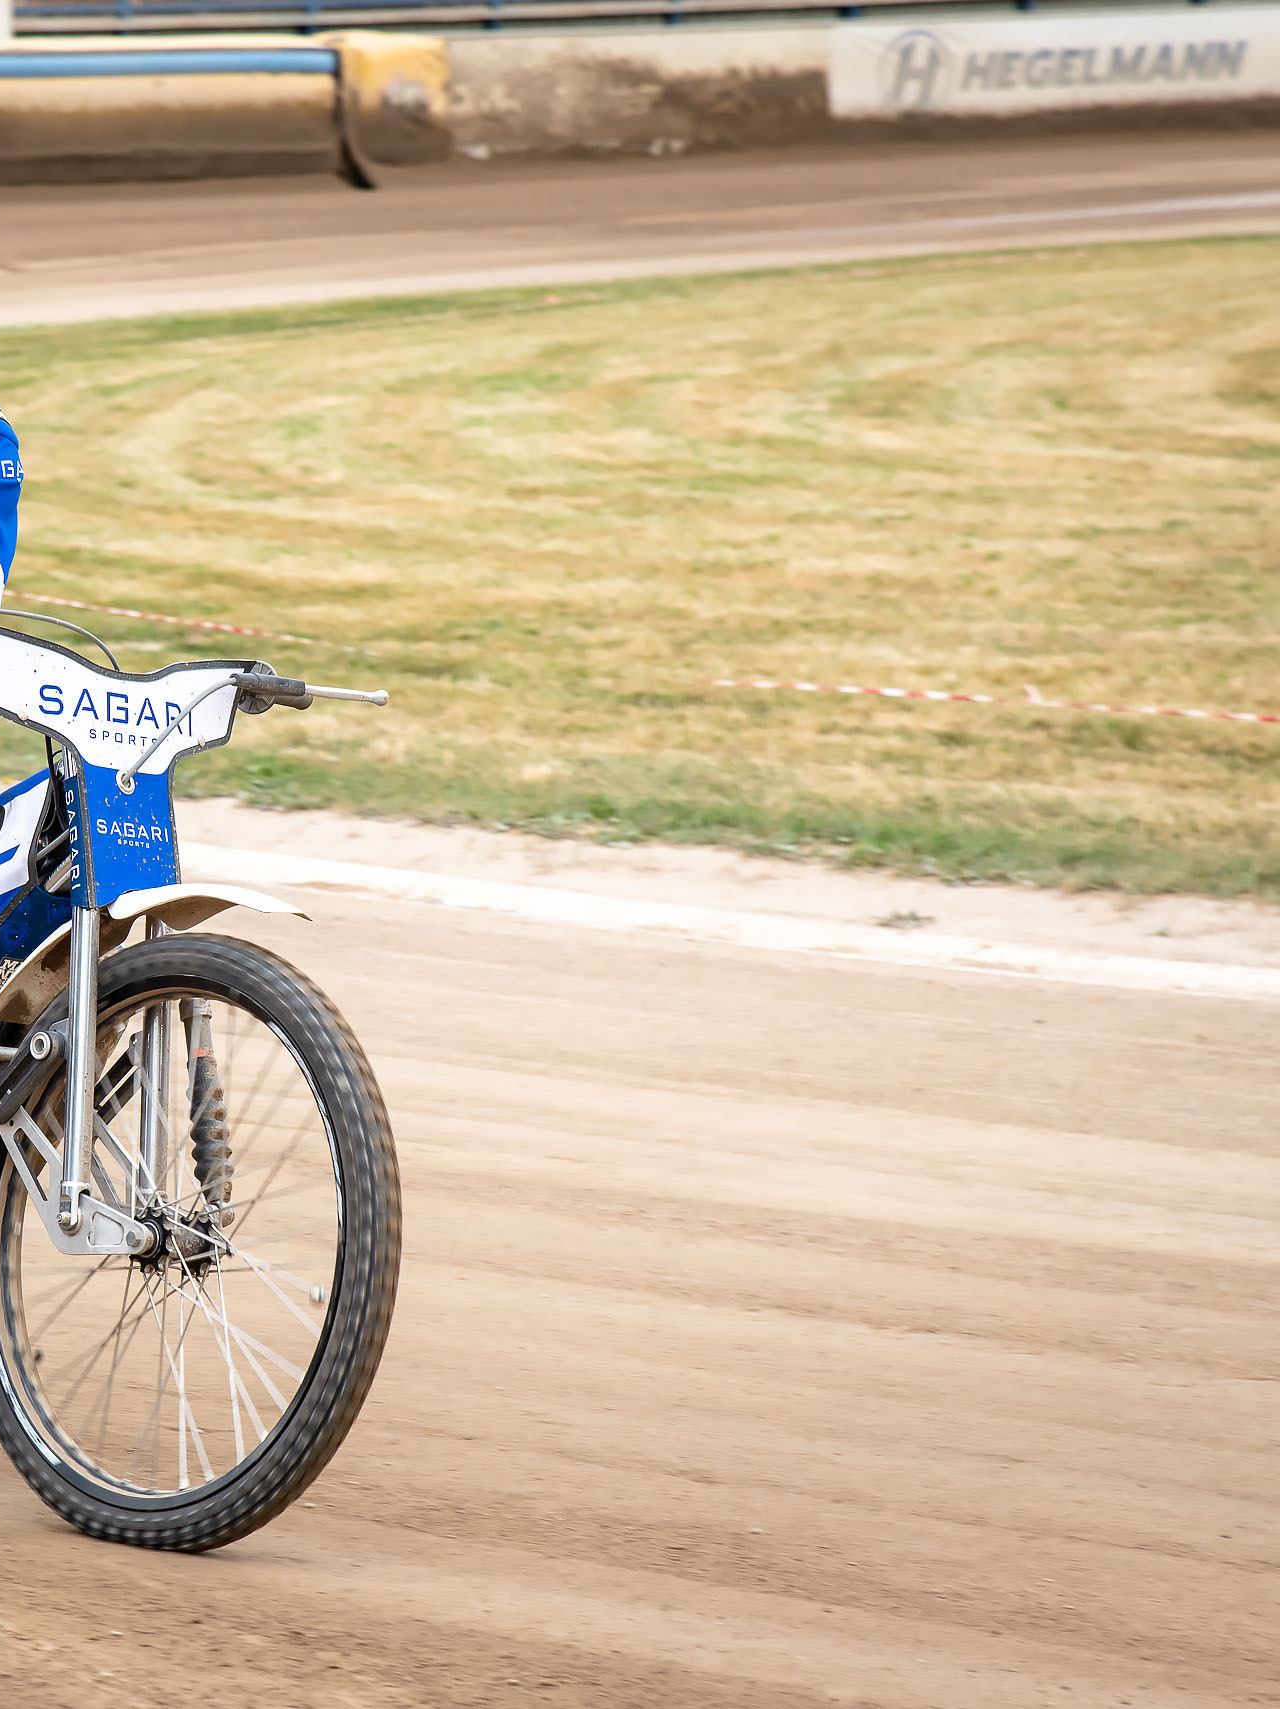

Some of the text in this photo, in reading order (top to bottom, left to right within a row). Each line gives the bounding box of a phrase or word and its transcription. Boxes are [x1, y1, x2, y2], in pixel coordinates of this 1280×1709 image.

[960, 40, 1247, 91] HEGELMANN
[38, 684, 192, 737] SAGARI
[65, 789, 81, 891] SAGARI
[96, 818, 170, 843] SAGARI
[117, 838, 150, 850] SPORTS
